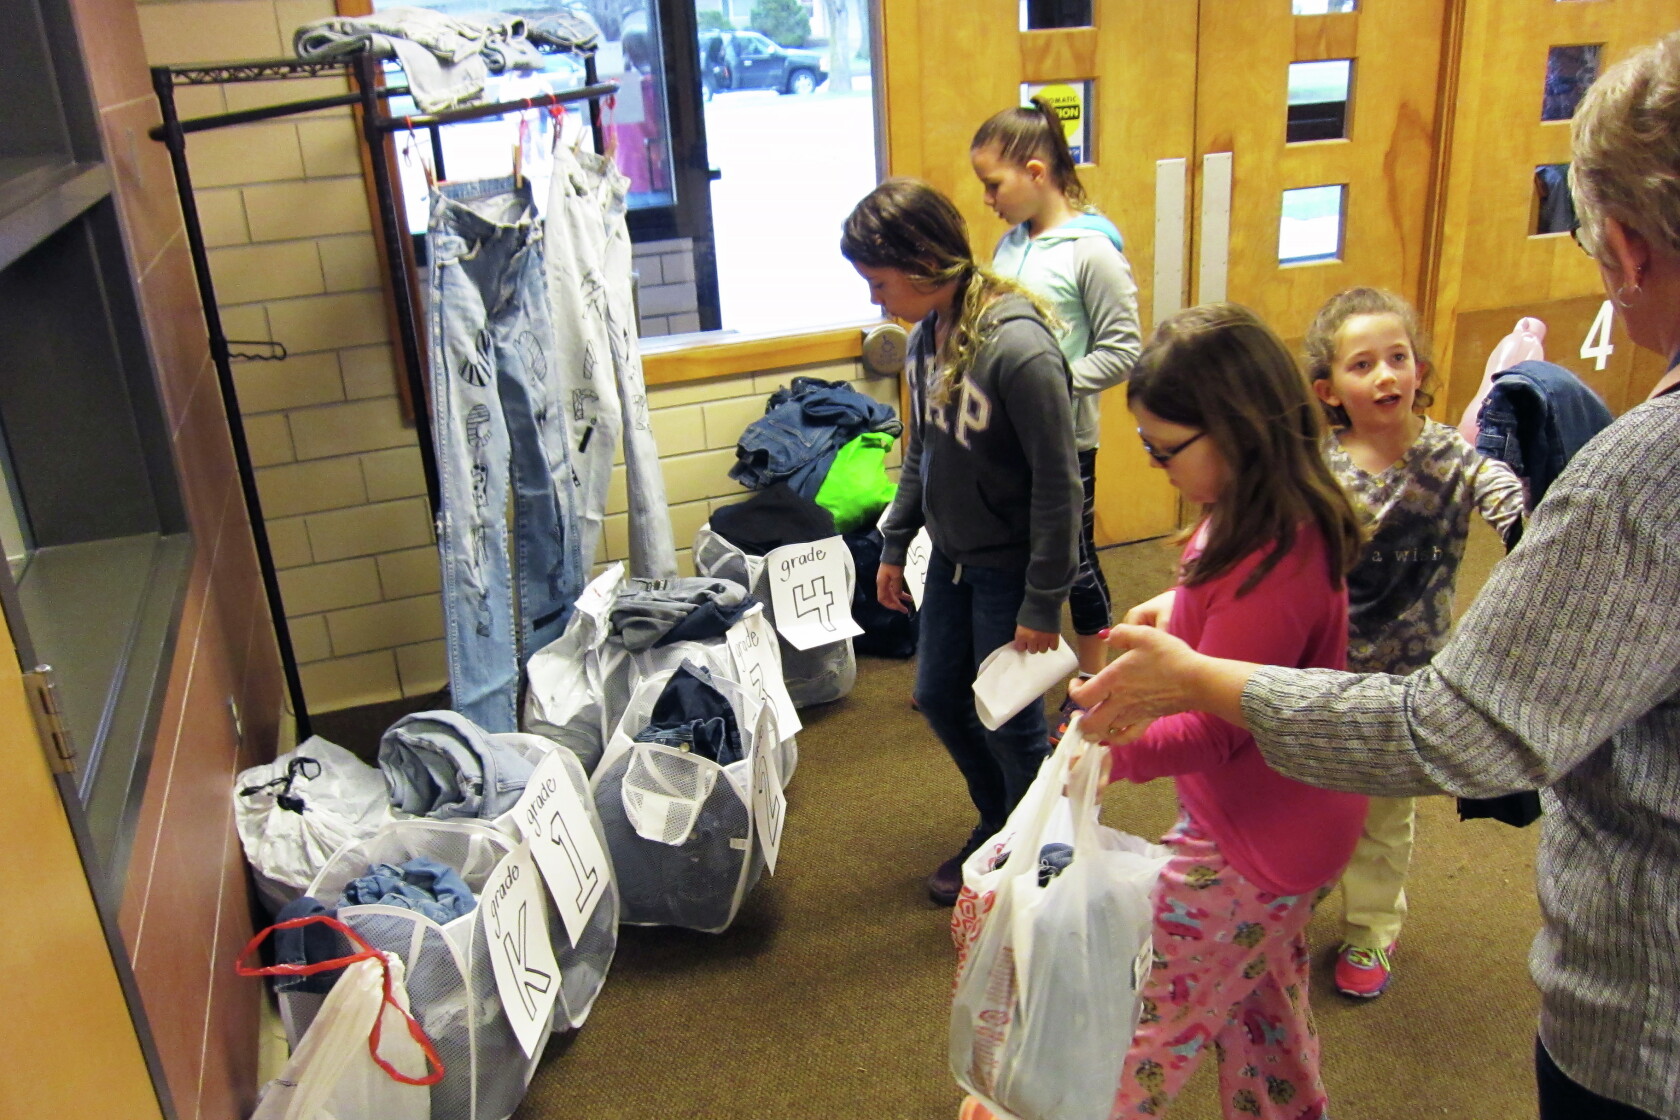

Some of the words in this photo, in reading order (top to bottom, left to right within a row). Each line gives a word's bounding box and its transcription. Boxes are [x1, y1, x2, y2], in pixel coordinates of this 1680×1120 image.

[1050, 96, 1077, 104] OMATIC
[1580, 299, 1614, 371] 4
[780, 547, 827, 582] grade
[1394, 546, 1444, 562] wih
[792, 575, 837, 633] 4
[526, 777, 557, 838] grade
[758, 755, 781, 848] 2
[550, 810, 599, 914] 1
[490, 864, 520, 940] grade
[503, 900, 551, 1022] K
